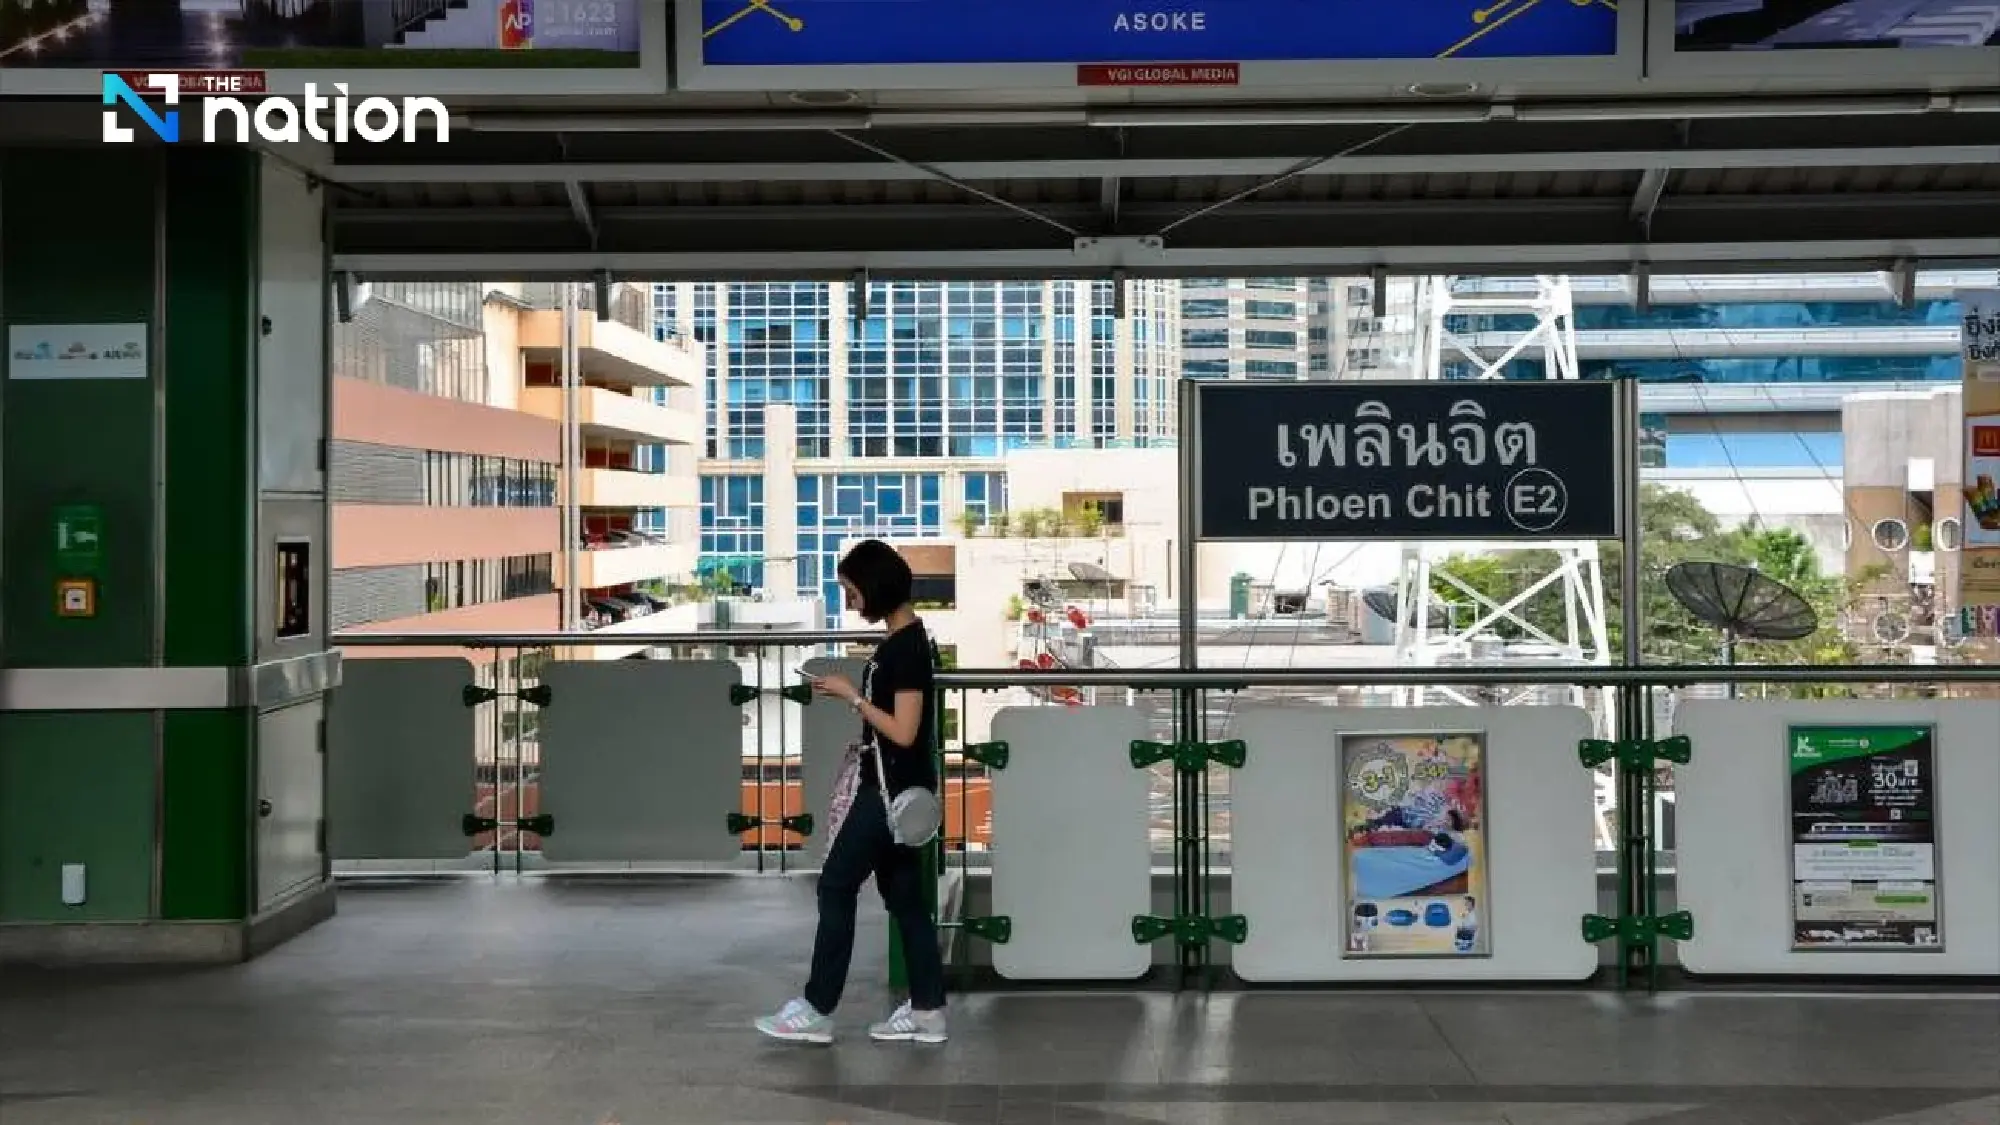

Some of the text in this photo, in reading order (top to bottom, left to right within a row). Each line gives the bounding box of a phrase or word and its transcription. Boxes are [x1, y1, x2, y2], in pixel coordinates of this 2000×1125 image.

[1113, 11, 1206, 32] ASOKE
[1108, 68, 1235, 81] VGI GLOBAL MEDIA
[1277, 400, 1537, 468] เพลินจิต
[1248, 484, 1559, 521] Phloen Chit E2
